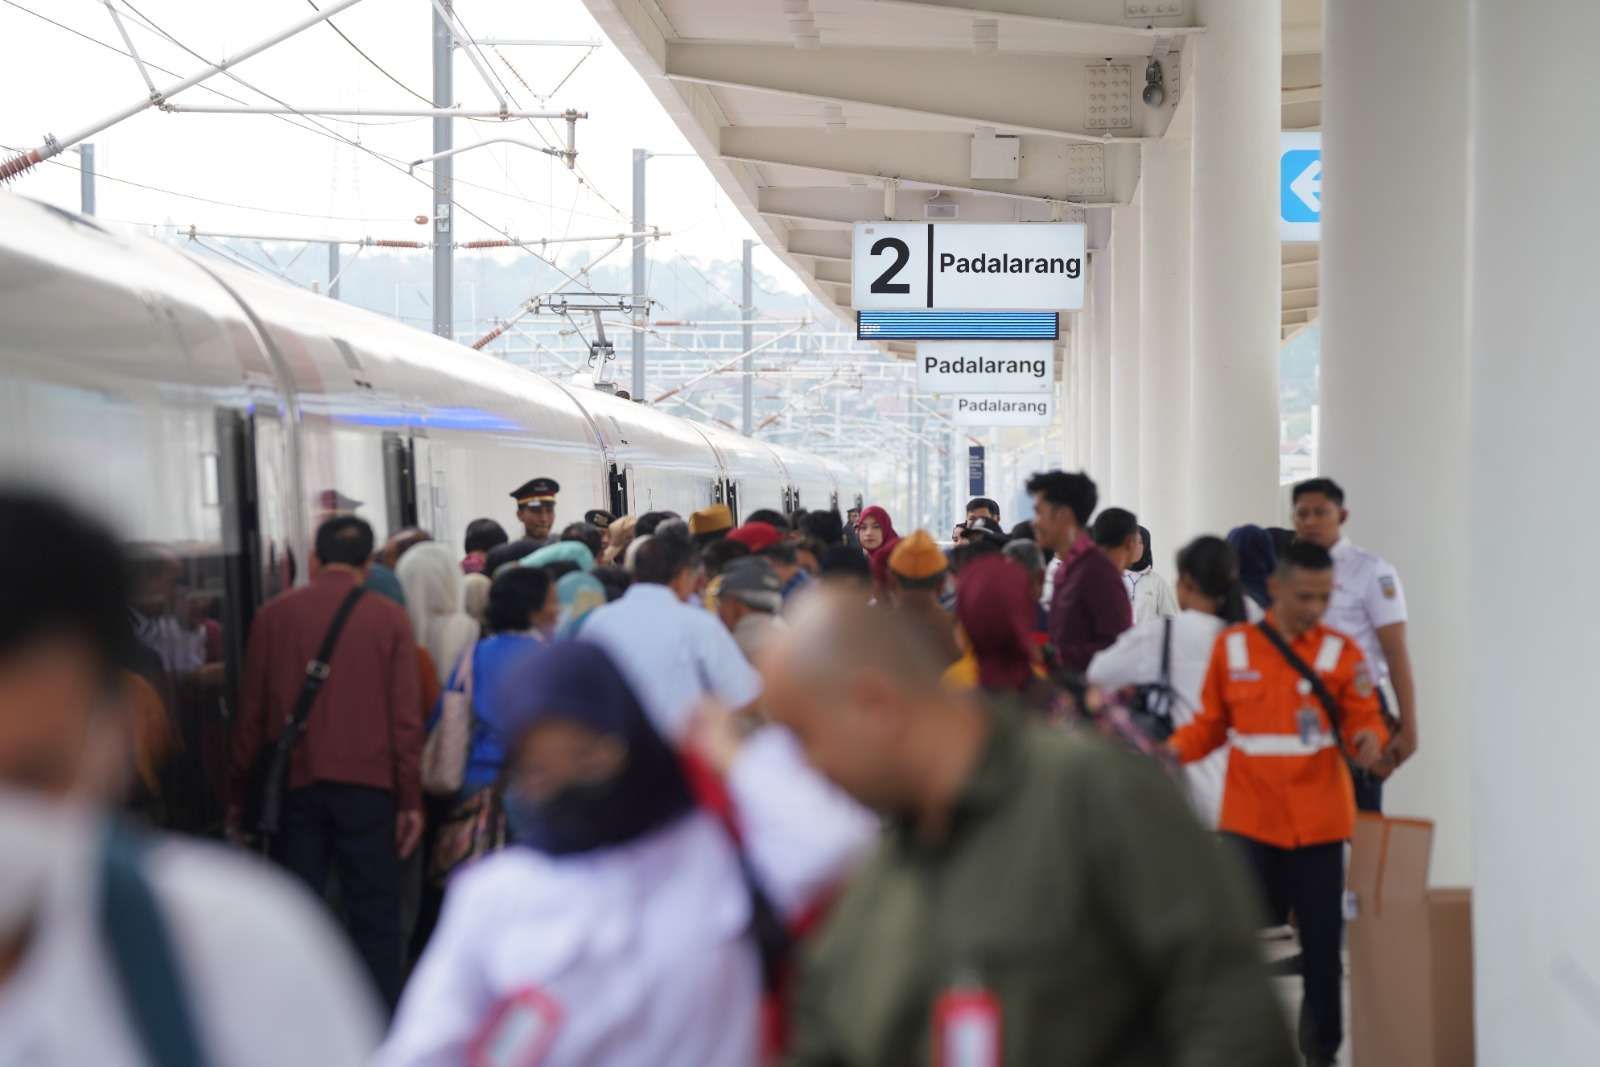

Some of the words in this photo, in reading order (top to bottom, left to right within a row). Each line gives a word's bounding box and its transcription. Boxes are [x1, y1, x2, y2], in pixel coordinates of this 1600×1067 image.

[870, 237, 910, 294] 2
[940, 253, 1081, 279] Padalarang
[925, 356, 1046, 378] Padalarang
[958, 399, 1047, 416] Padalarang
